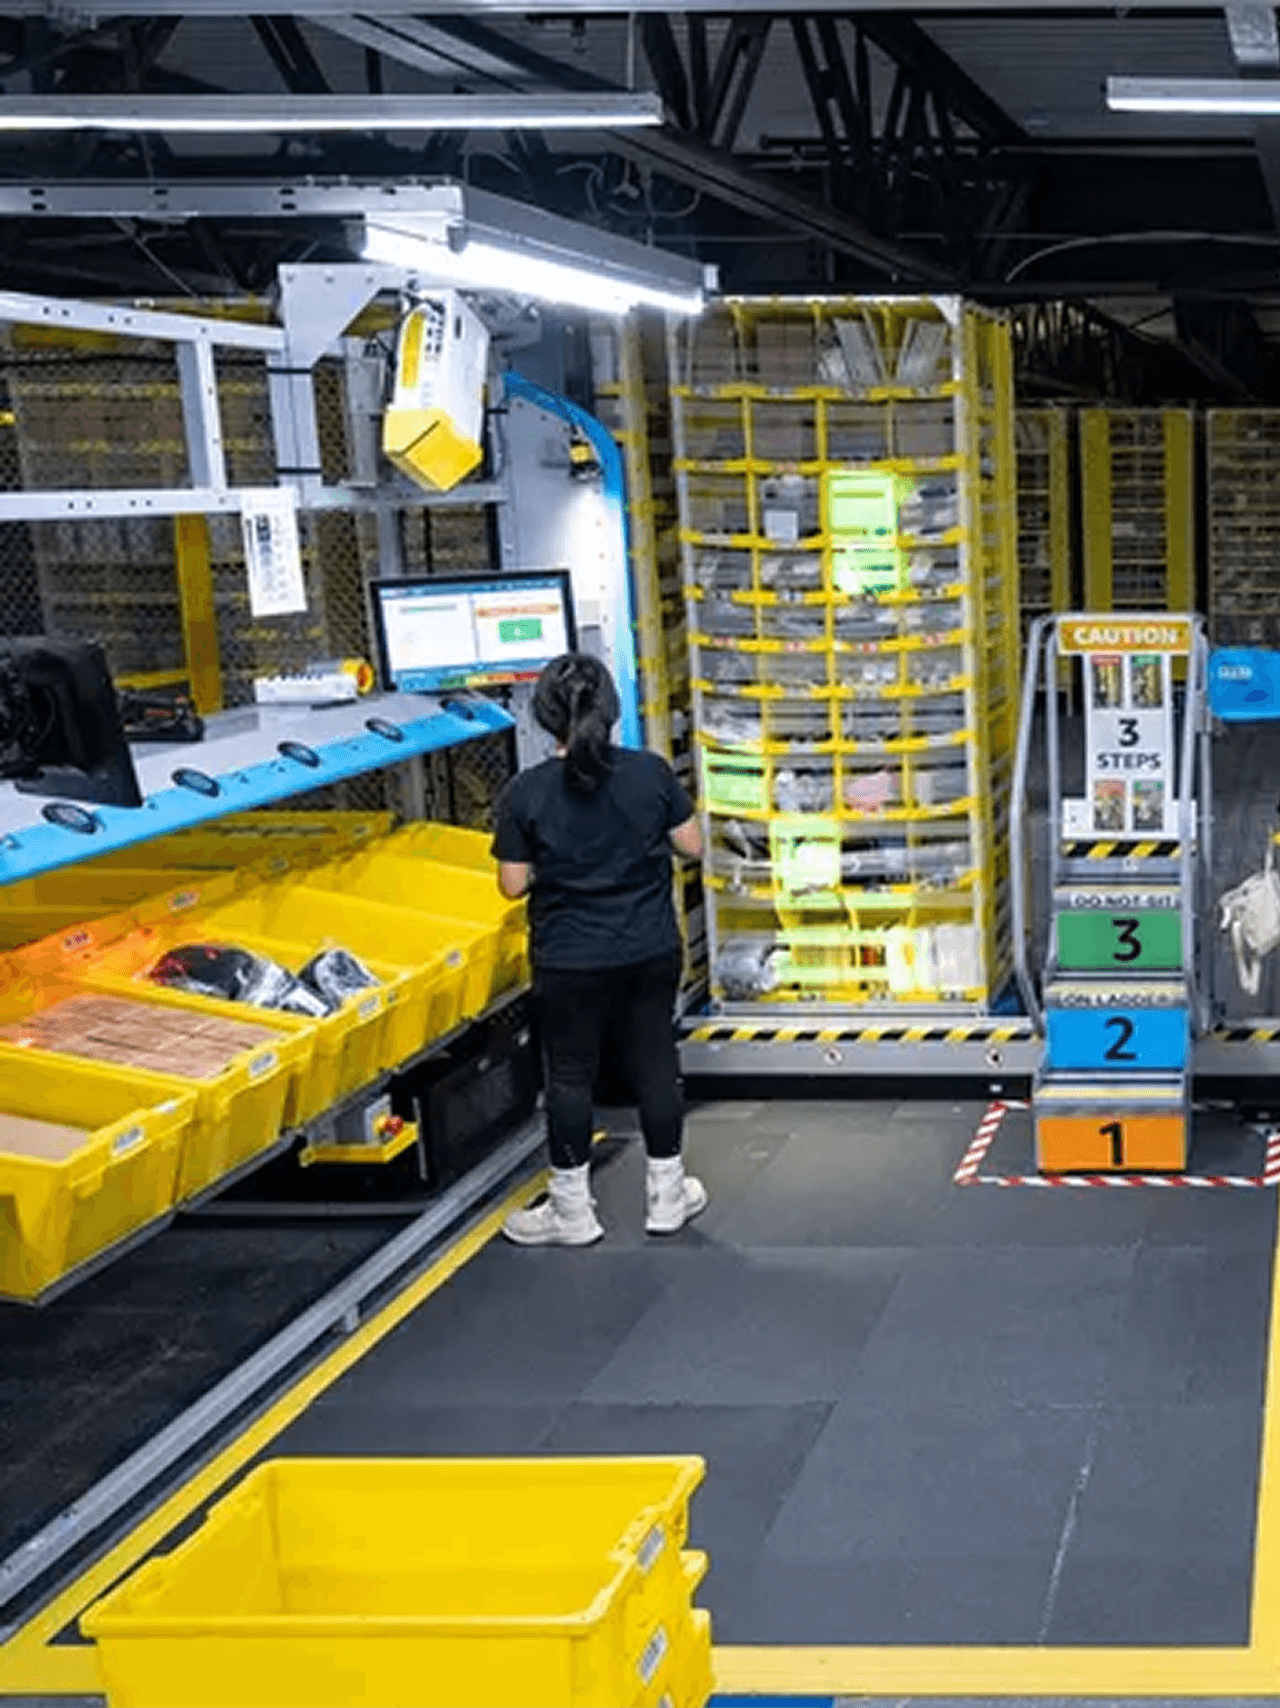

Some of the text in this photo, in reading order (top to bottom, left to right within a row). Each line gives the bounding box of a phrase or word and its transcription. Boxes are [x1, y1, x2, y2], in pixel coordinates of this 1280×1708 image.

[1072, 626, 1179, 645] CAUTION
[1118, 718, 1140, 747] 3
[1096, 753, 1162, 769] STEPS
[1074, 894, 1101, 906] DO
[1105, 894, 1139, 906] NOT
[1112, 918, 1142, 962] 3
[1103, 1015, 1138, 1061] 2
[1098, 1121, 1124, 1166] 1
